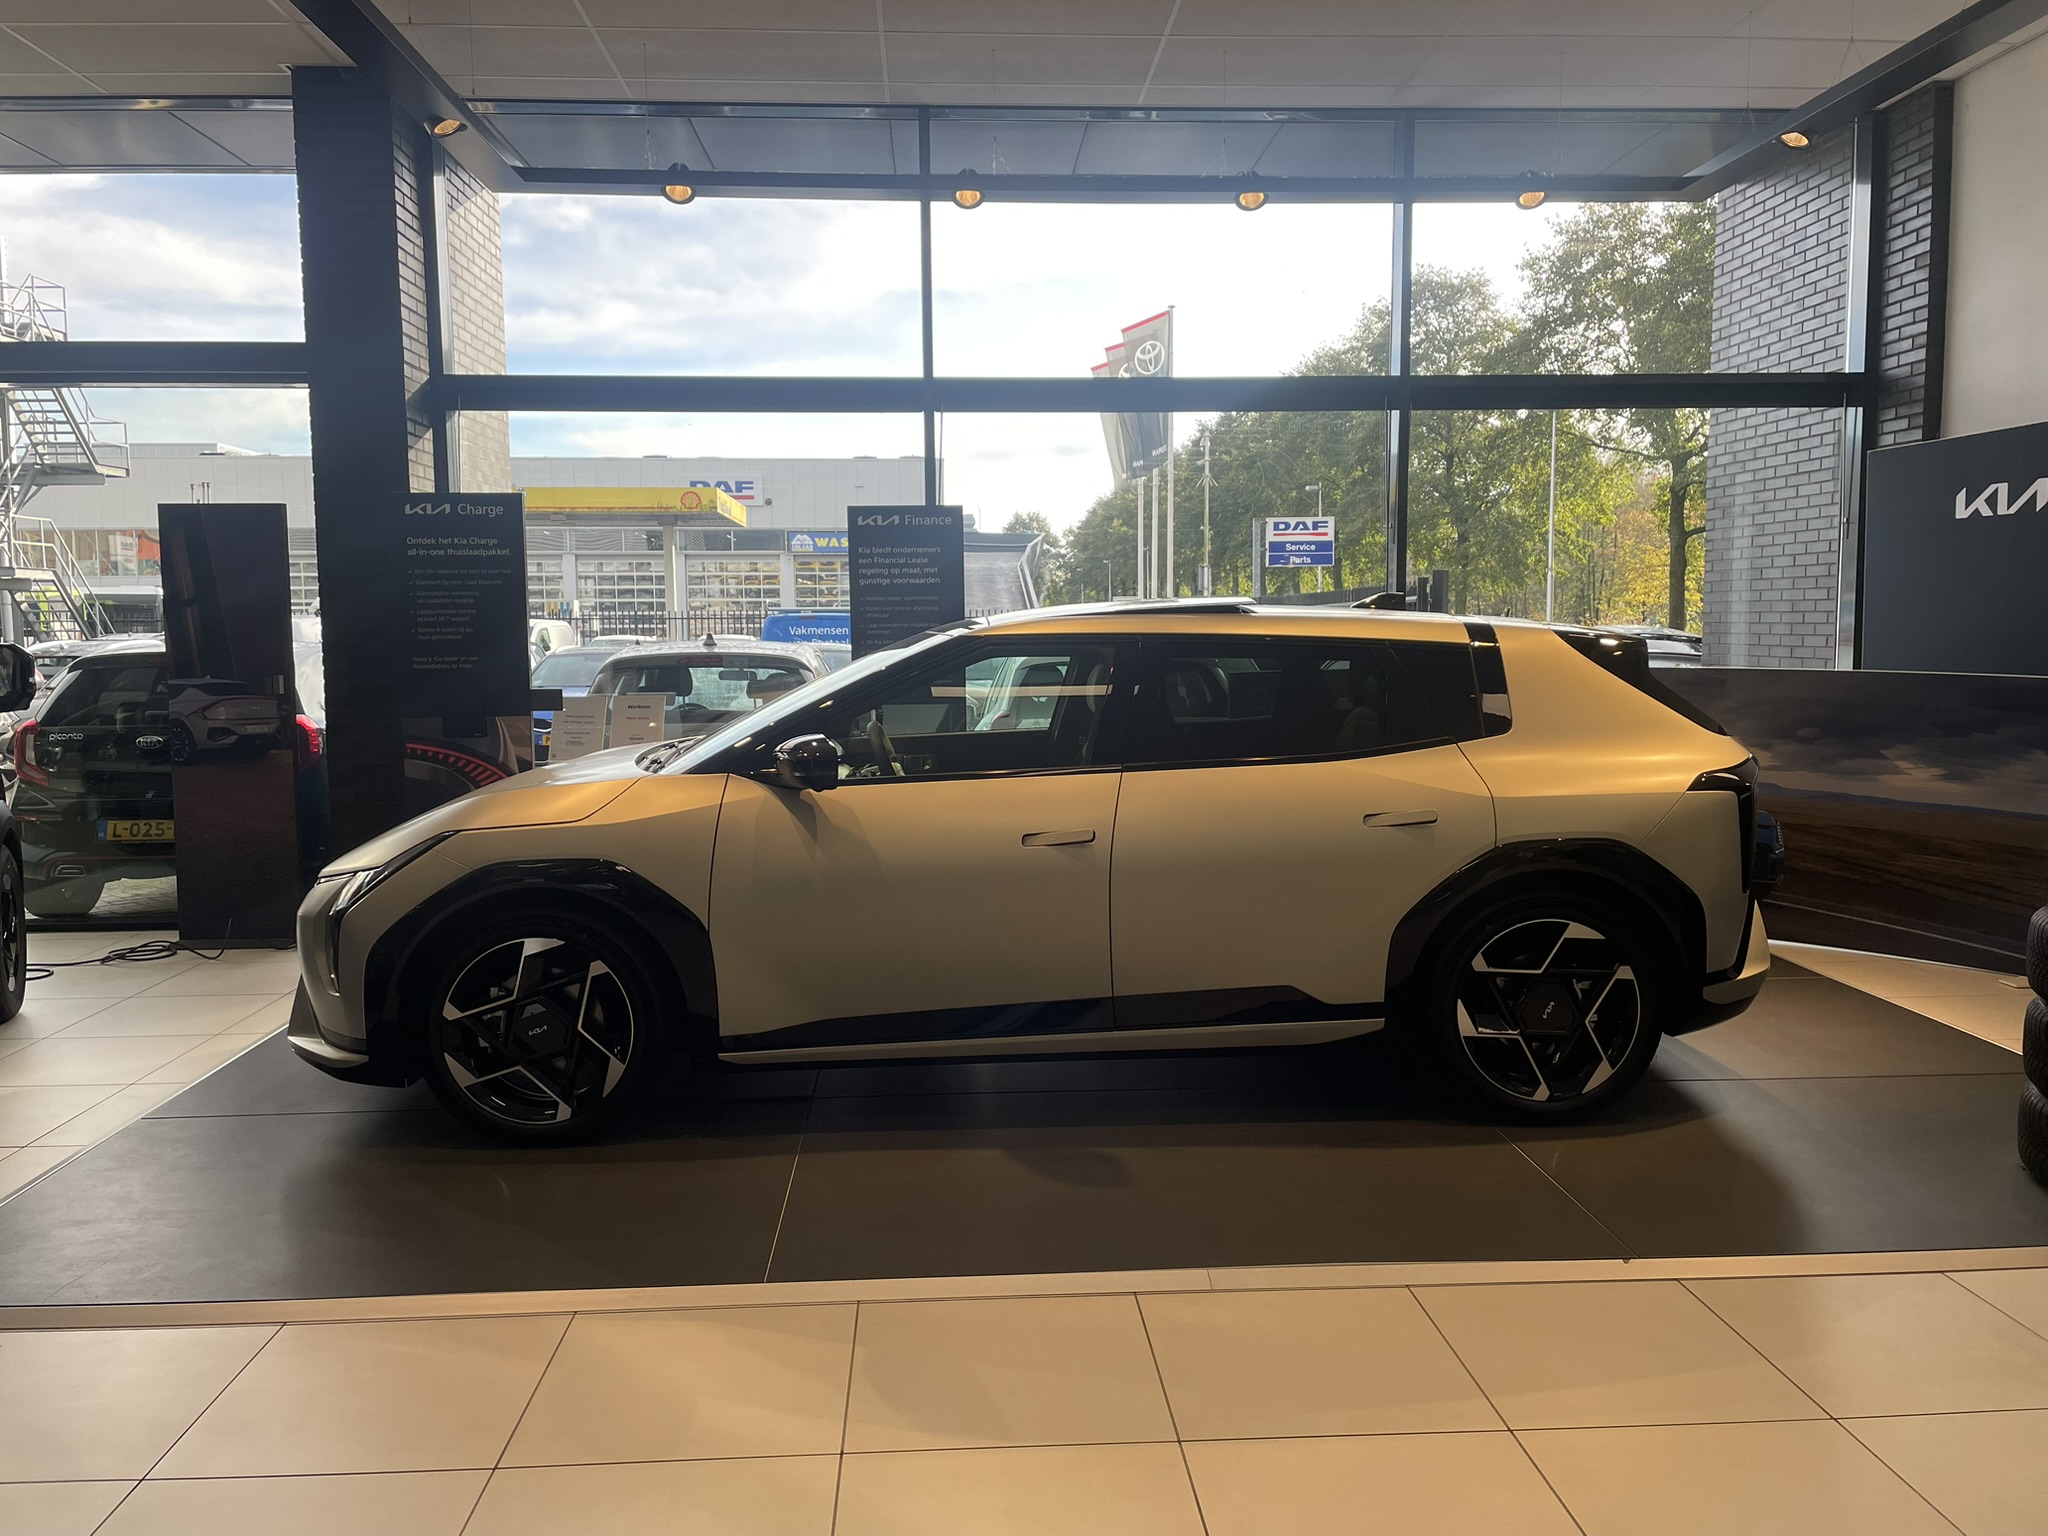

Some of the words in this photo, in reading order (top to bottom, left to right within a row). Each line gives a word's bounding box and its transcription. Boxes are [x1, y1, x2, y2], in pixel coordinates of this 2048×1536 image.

[689, 480, 754, 493] DAF
[457, 503, 504, 518] Charge
[904, 514, 952, 526] Finance
[1273, 520, 1328, 531] DAF
[406, 536, 436, 545] Ontdek
[469, 537, 498, 546] Charge
[407, 548, 445, 556] all-in-one
[447, 548, 512, 557] thuislaadpakket.
[859, 568, 889, 576] regeling
[788, 626, 849, 635] Vakmensen
[49, 732, 84, 742] picanto
